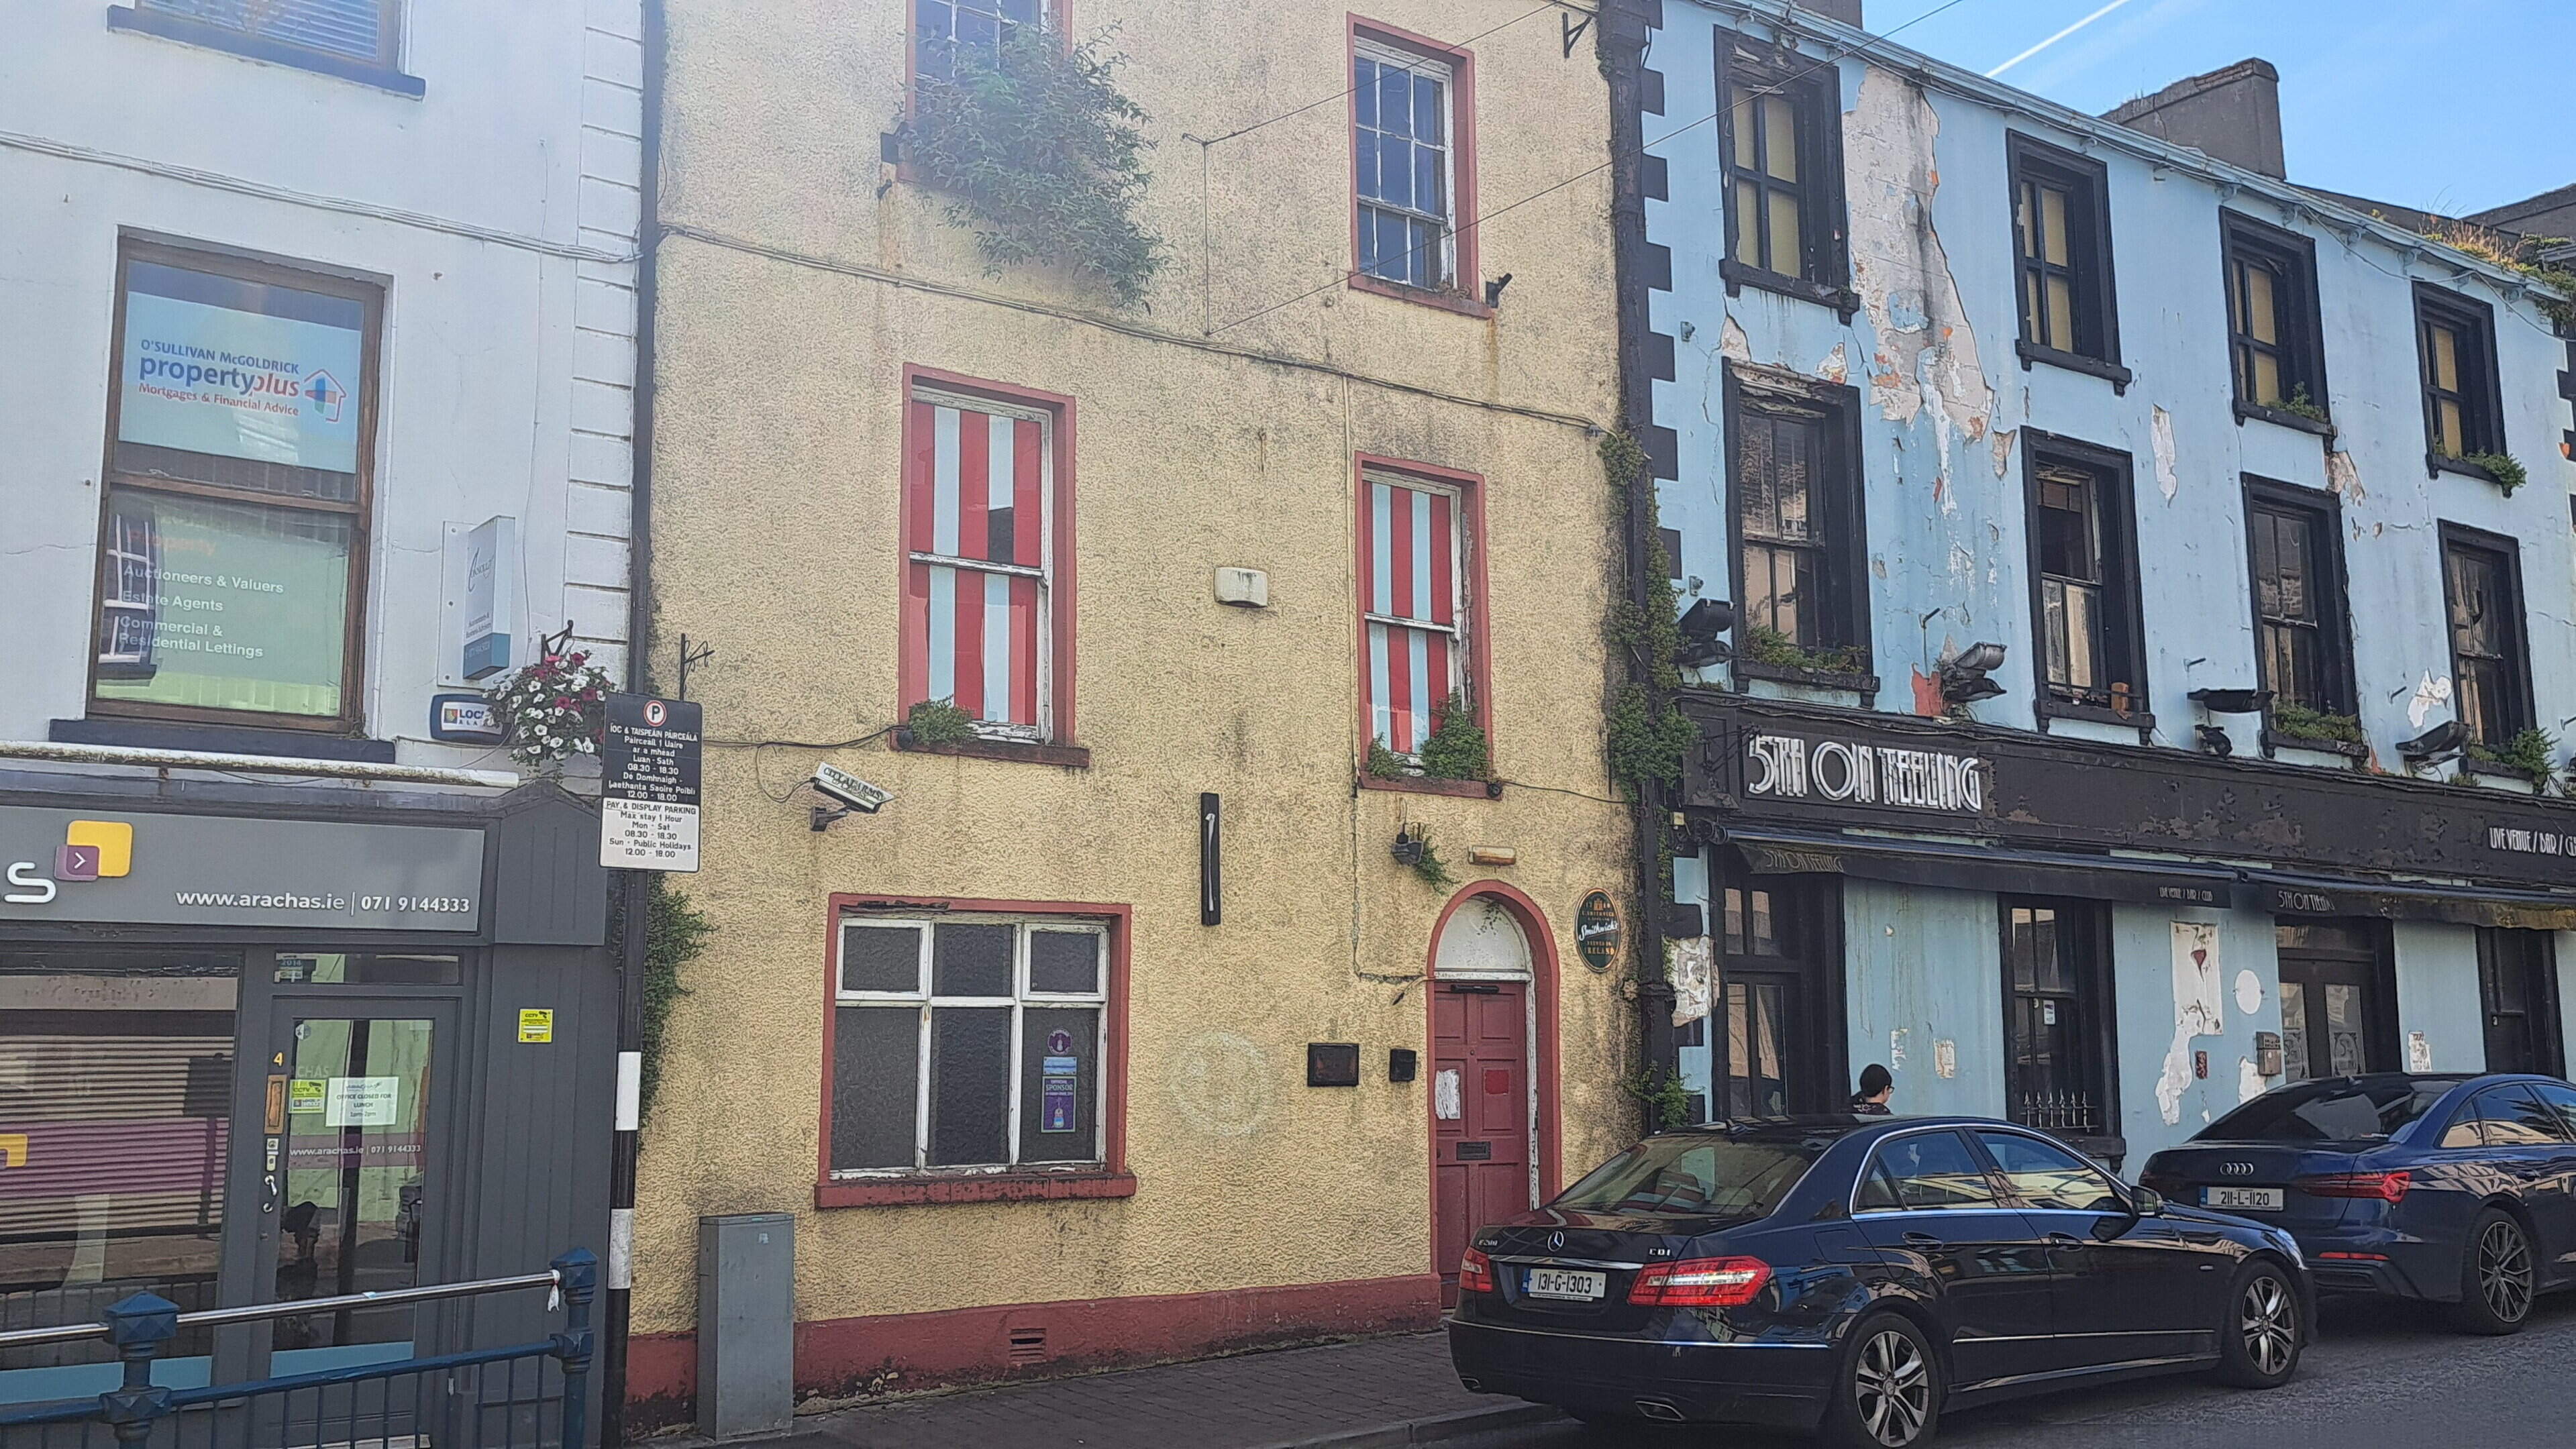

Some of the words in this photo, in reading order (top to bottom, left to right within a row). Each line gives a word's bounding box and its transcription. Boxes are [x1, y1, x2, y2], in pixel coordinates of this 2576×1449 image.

[141, 339, 215, 361] O'SULLIVAN
[219, 352, 300, 374] McGOLDRICK
[138, 383, 197, 401] Mortgages
[201, 394, 210, 403] &
[213, 394, 260, 411] Financial
[263, 402, 299, 416] Advice
[123, 565, 213, 586] Auctioneers
[217, 576, 227, 588] &
[231, 576, 285, 594] Valuers
[123, 590, 169, 605] Estate
[172, 595, 223, 611] Agents
[120, 615, 208, 635] Commercial
[212, 625, 223, 637] &
[119, 633, 201, 651] Residential
[205, 641, 264, 659] Lettings
[651, 705, 661, 721] P
[633, 754, 650, 763] Luan
[656, 757, 674, 765] Sath
[627, 763, 650, 772] 08.30
[659, 766, 679, 775] 18.30
[1748, 735, 1808, 797] 5TH
[1811, 741, 1876, 804] ON
[1876, 746, 1982, 813] TEELING
[636, 773, 677, 785] Domhnaigh
[650, 784, 673, 793] Saoire
[627, 790, 648, 800] 12.00
[657, 793, 678, 802] 18.00
[607, 800, 620, 809] PAY
[631, 803, 662, 812] DISPLAY
[664, 805, 697, 815] PARKING
[639, 813, 656, 822] stay
[665, 814, 682, 822] Hour
[632, 821, 648, 829] Mon
[625, 829, 648, 838] 08.30
[657, 832, 677, 841] 18.30
[609, 837, 624, 845] Sun
[633, 839, 657, 848] Public
[660, 841, 691, 851] Holidays
[625, 847, 646, 856] 12.00
[655, 850, 676, 858] 18.00
[176, 890, 345, 910] www.arachas.ie
[361, 896, 390, 912] 071
[398, 896, 470, 913] 9144333
[1578, 919, 1619, 941] Smithwick's
[273, 1051, 285, 1067] 4
[1045, 1083, 1074, 1091] SPONSOR
[370, 1145, 385, 1154] 071
[388, 1144, 421, 1153] 9144333
[2220, 1191, 2270, 1205] 211-L-1120
[1649, 1248, 1671, 1256] CDI
[1537, 1272, 1592, 1294] 131-G-1303
